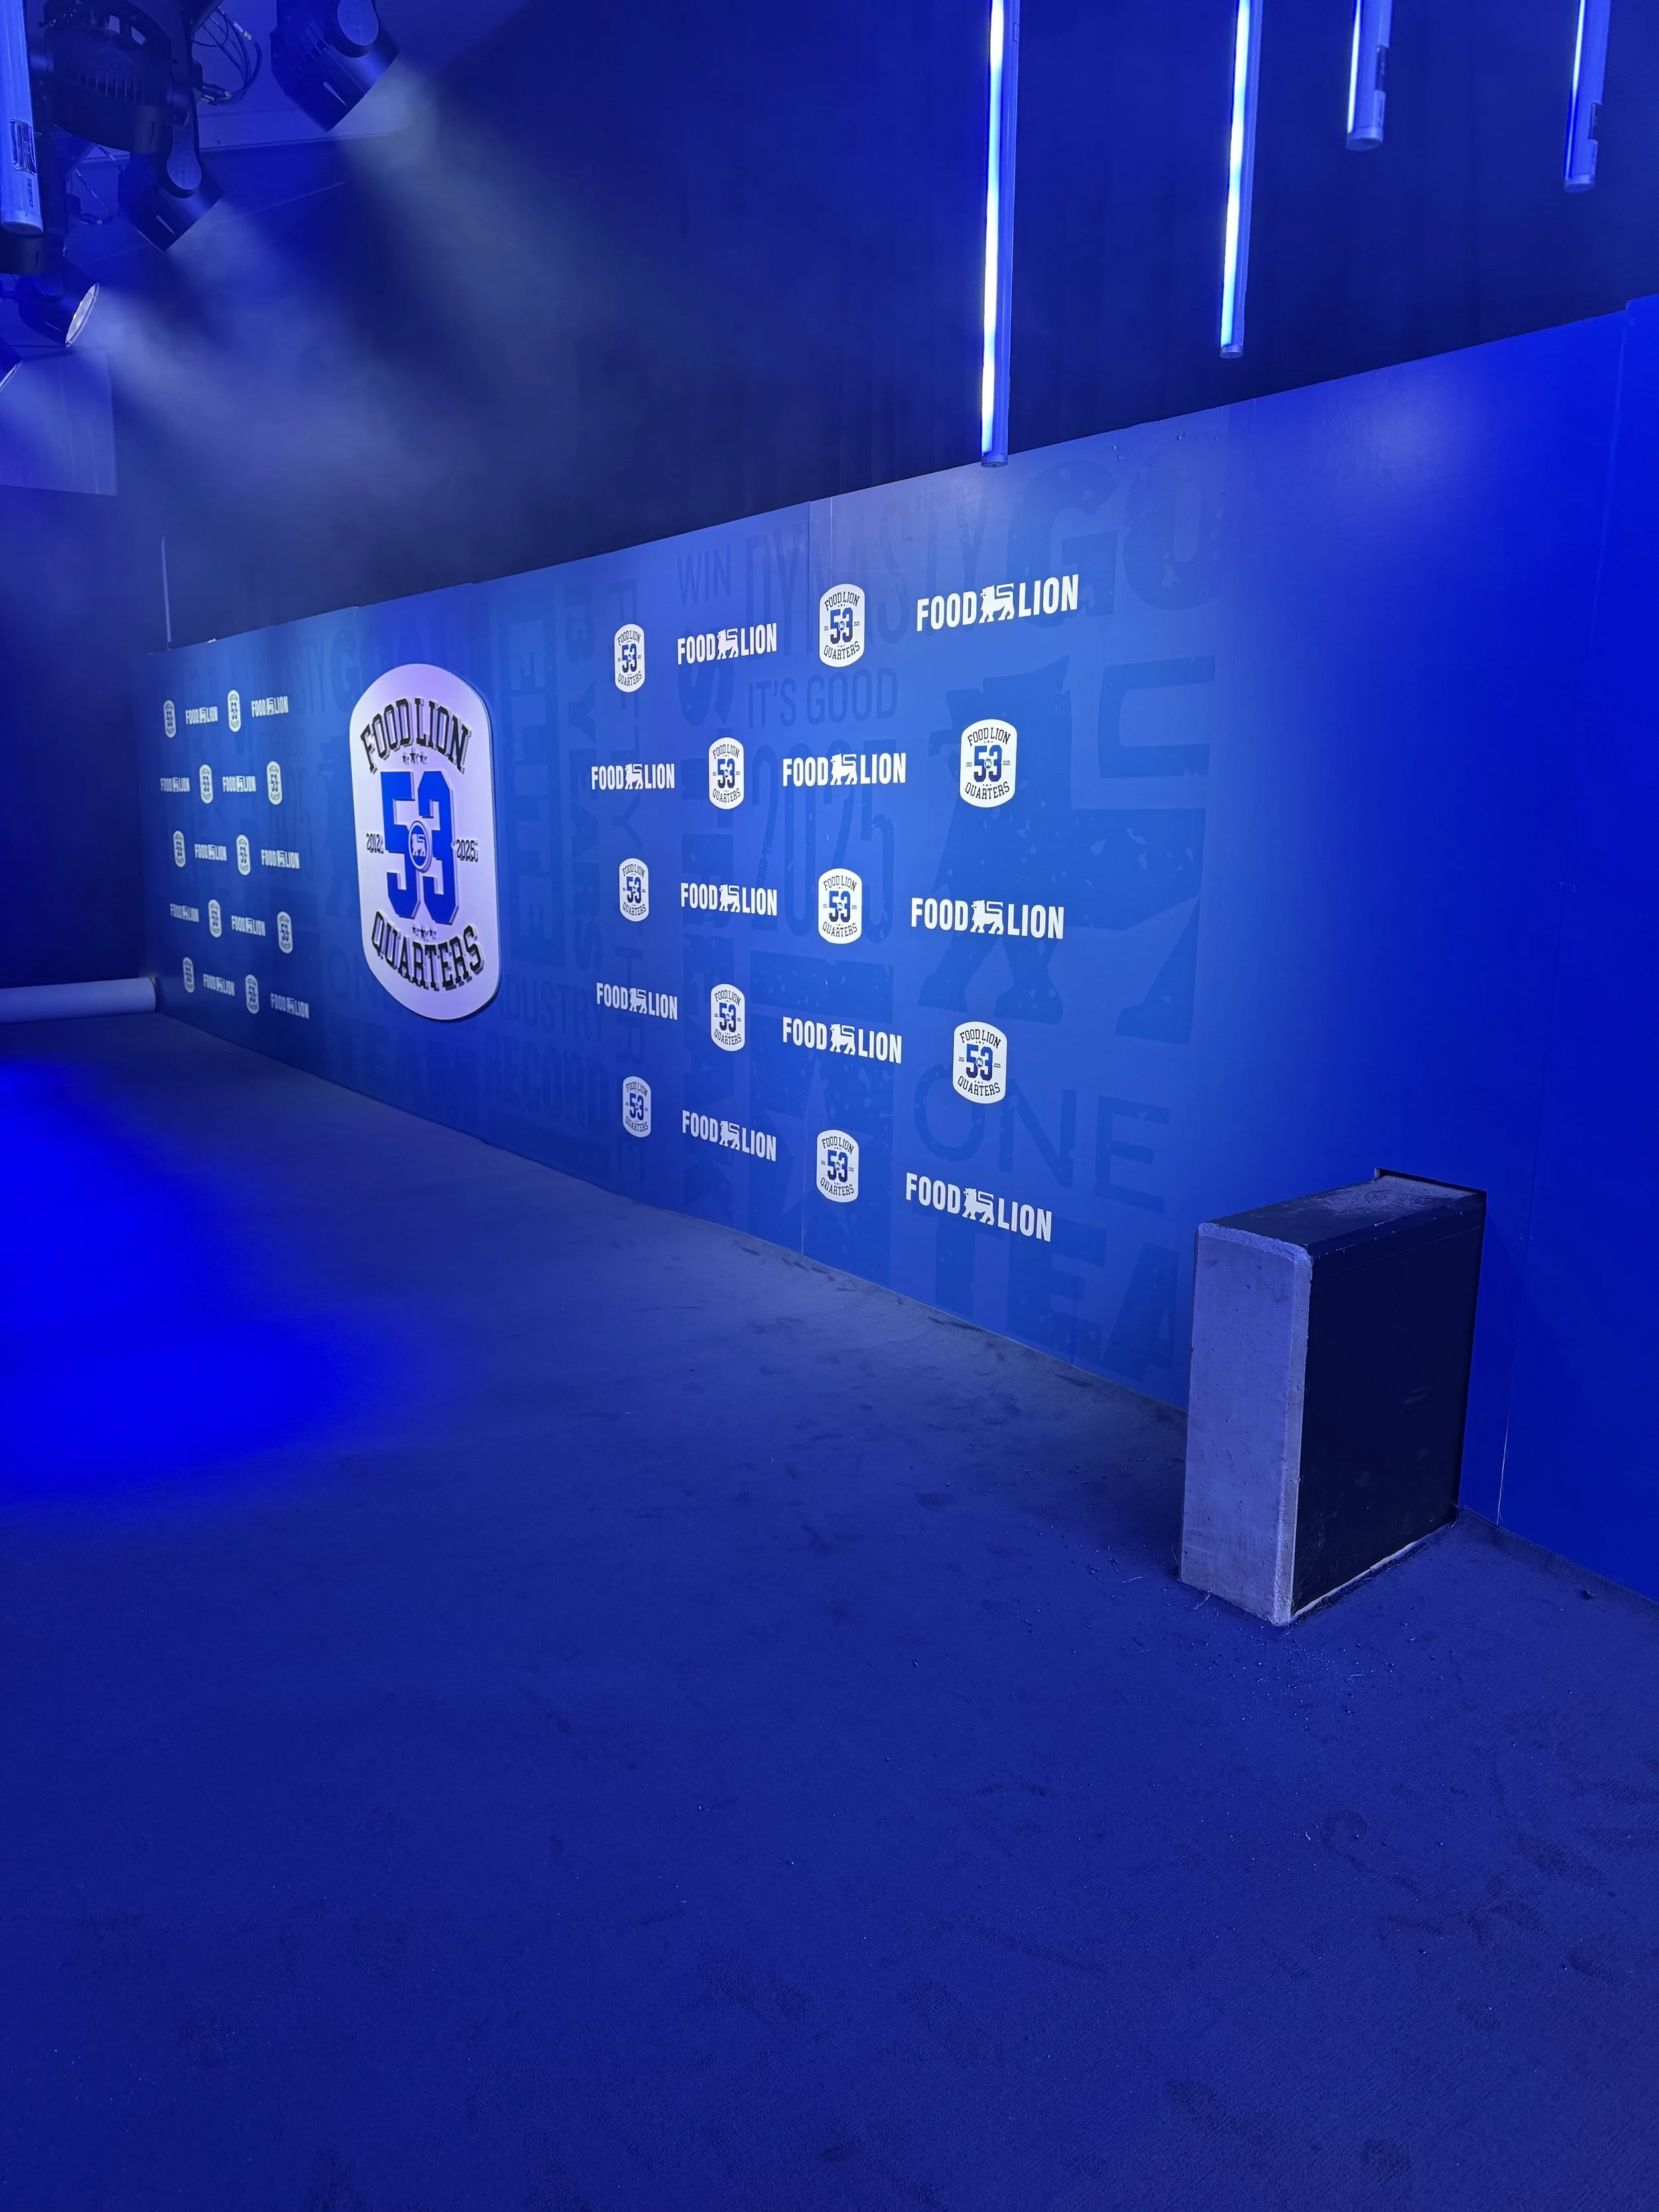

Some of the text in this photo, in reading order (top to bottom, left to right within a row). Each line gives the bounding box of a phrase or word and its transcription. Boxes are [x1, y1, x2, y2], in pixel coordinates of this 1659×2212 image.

[677, 546, 731, 605] WIN
[824, 591, 860, 611] FOOD LION
[916, 574, 1079, 631] FOOD LION
[830, 607, 853, 644] 53
[622, 643, 637, 673] 53
[677, 623, 777, 664] FOOD LION
[824, 641, 860, 659] QUARTERS
[748, 667, 899, 729] IT'S GOOD
[360, 698, 471, 774] FOOD LION
[713, 744, 740, 759] FOOD LION
[968, 727, 1011, 747] FOOD LION
[591, 763, 675, 790] FOOD LION
[717, 758, 735, 788] 53
[782, 753, 906, 786] FOOD LION
[974, 745, 1002, 782] 53
[712, 788, 741, 803] QUARTERS
[965, 782, 1009, 799] QUARTERS
[366, 833, 384, 854] 2012
[380, 771, 459, 924] 53
[456, 839, 478, 862] 2025
[750, 737, 897, 942] 2025
[626, 877, 641, 903] 53
[824, 875, 857, 891] FOOD LION
[680, 883, 778, 916] FOOD LION
[829, 891, 851, 922] 53
[822, 921, 857, 937] QUARTERS
[910, 897, 1064, 939] FOOD LION
[372, 910, 484, 991] QUARTERS
[596, 983, 678, 1020] FOOD LION
[715, 990, 741, 1005] FOOD LION
[719, 1002, 736, 1033] 53
[715, 1029, 741, 1045] QUARTERS
[782, 1017, 902, 1064] FOOD LION
[960, 1029, 1001, 1049] FOOD LION
[966, 1043, 993, 1081] 53
[958, 1076, 1001, 1096] QUARTERS
[630, 1092, 644, 1121] 53
[682, 1110, 776, 1161] FOOD LION
[822, 1136, 854, 1154] FOOD LION
[912, 1063, 1170, 1213] ONE
[828, 1149, 847, 1183] 53
[820, 1177, 854, 1196] QUARTERS
[905, 1172, 1052, 1242] FOOD LION
